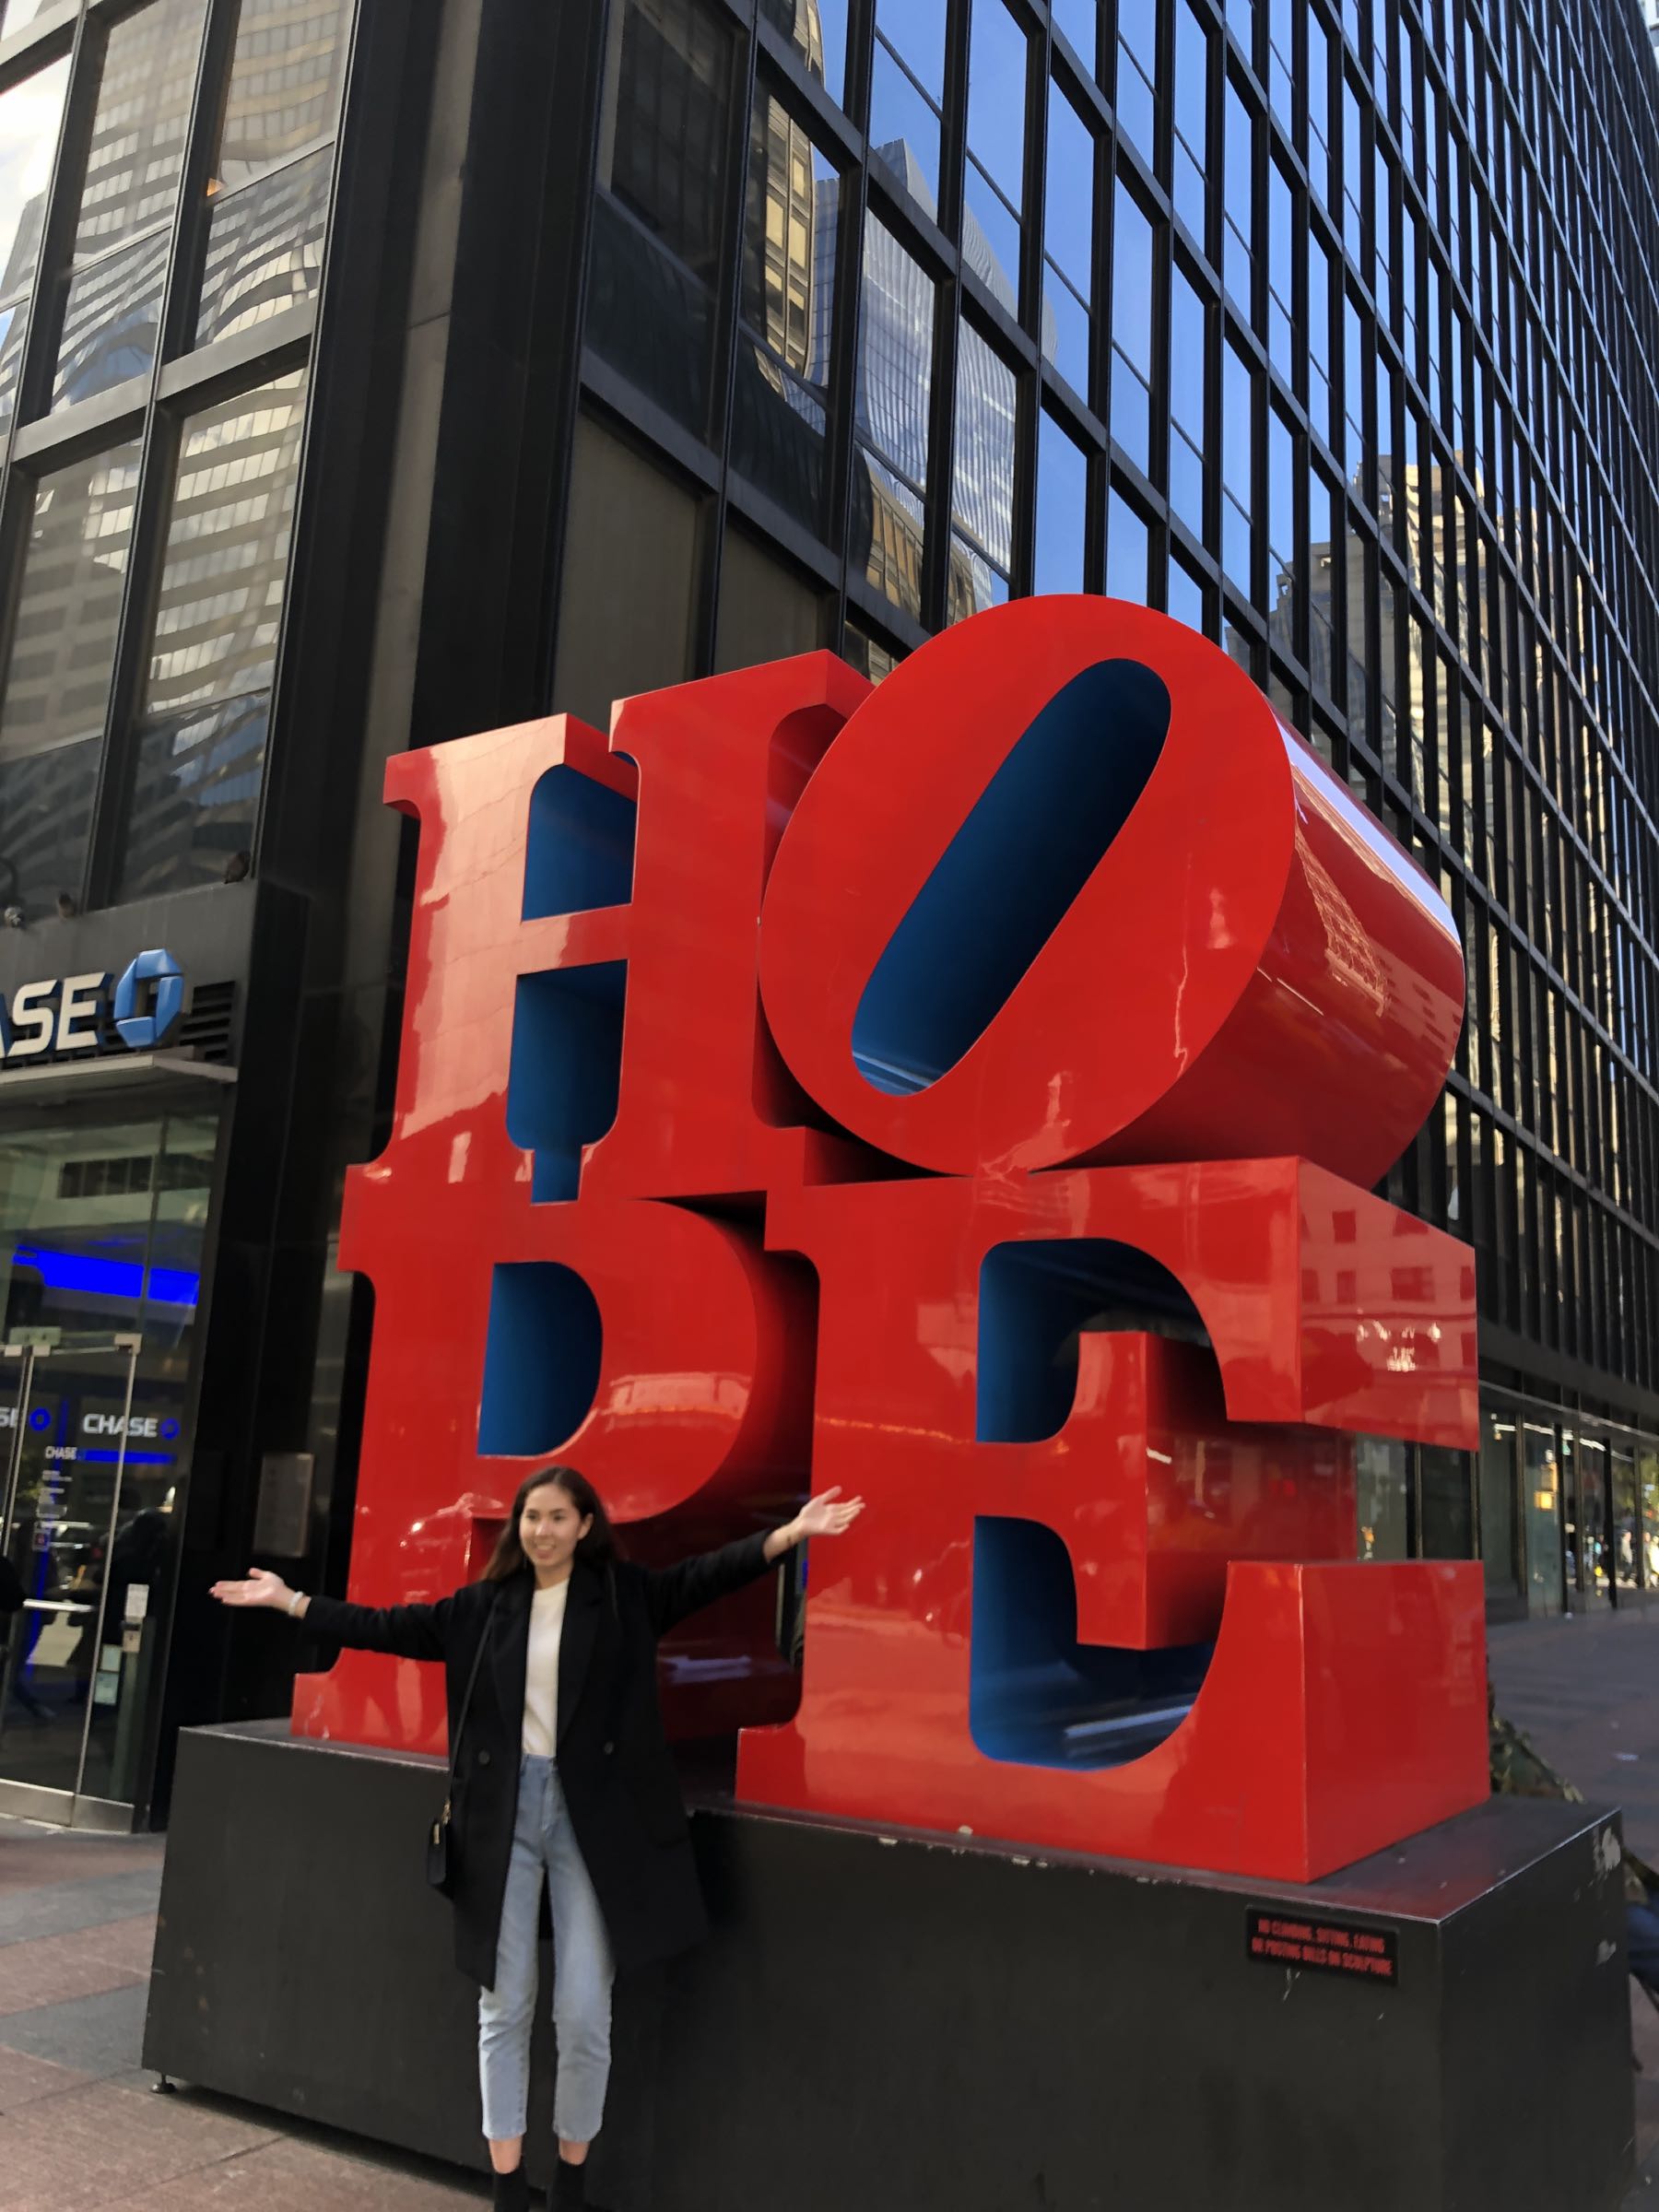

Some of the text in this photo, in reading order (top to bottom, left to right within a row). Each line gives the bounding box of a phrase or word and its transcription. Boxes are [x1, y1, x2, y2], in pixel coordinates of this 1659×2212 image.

[0, 971, 106, 1059] SE
[83, 1413, 158, 1438] CHASE
[45, 1445, 77, 1460] CHASE
